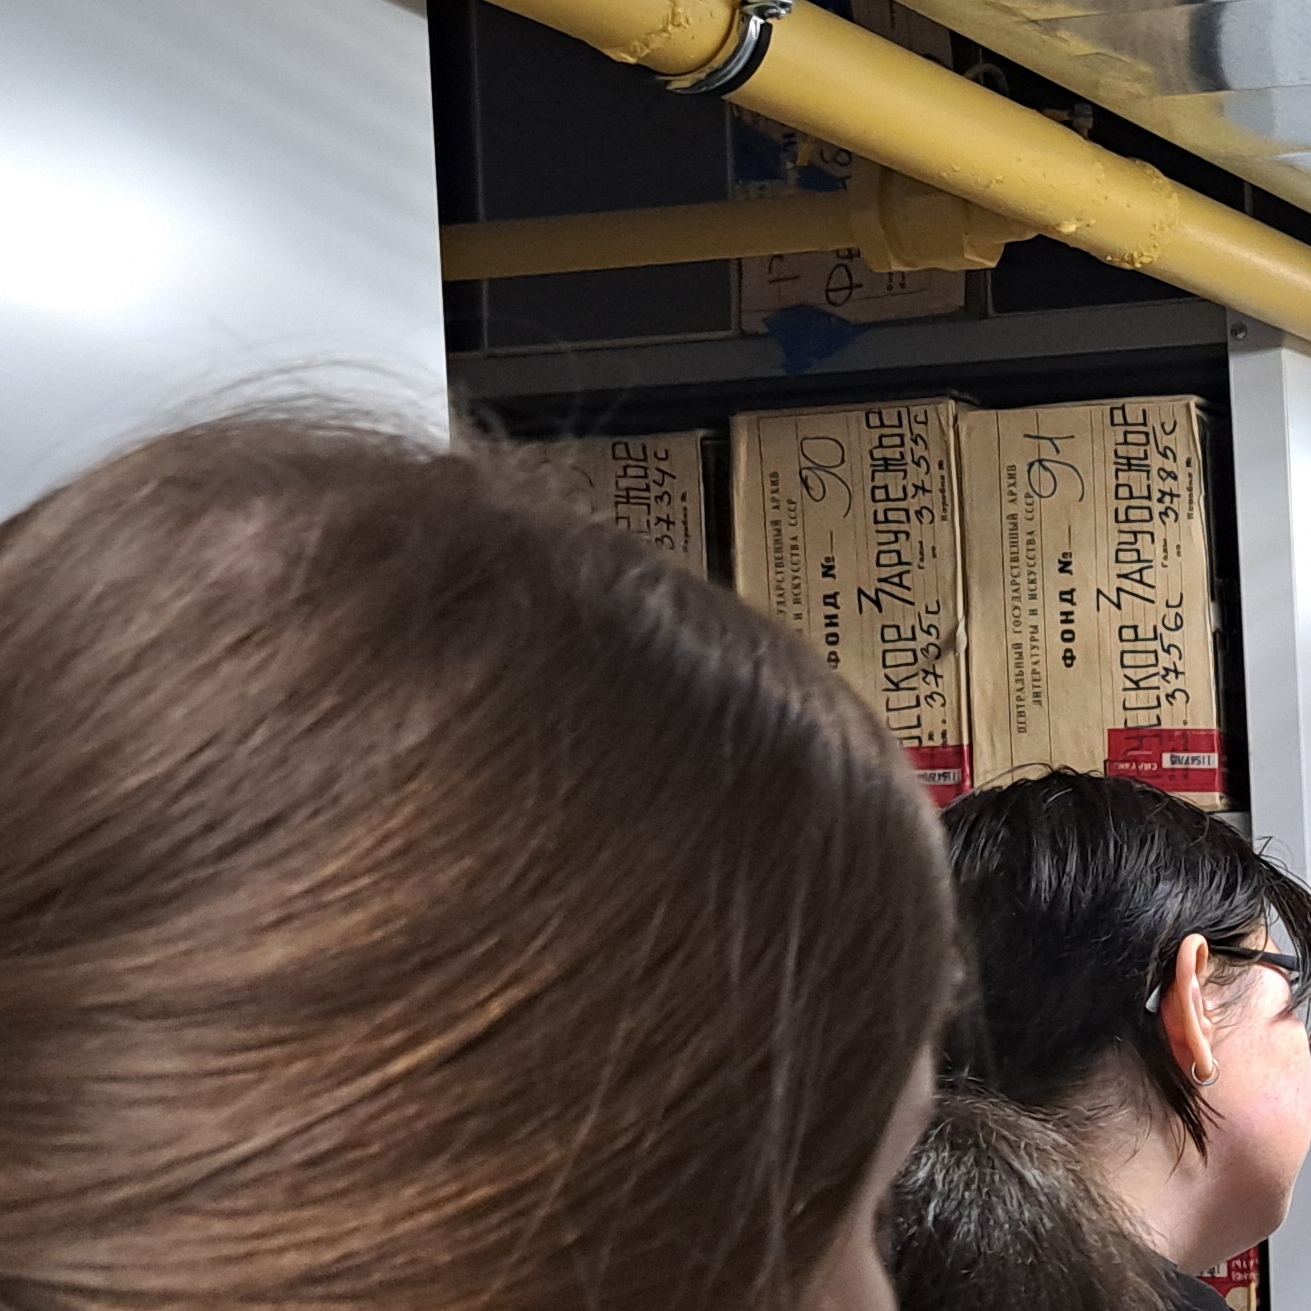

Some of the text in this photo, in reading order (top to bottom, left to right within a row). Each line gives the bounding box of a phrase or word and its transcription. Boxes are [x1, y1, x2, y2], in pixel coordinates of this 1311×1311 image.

[798, 435, 851, 519] 90
[1024, 432, 1085, 503] 91
[769, 470, 786, 617] УДАРСТВЕННЫЙ АРХИВ
[787, 498, 798, 527] СССР
[787, 534, 802, 605] ИСКУССТВА
[1005, 464, 1028, 734] ЦЕНТРАЛЬНЫЙ ГОСУДАРСТВЕННЫЙ АРХИВ
[1023, 491, 1043, 708] ЛИТЕРАТУРЫ И ИСКУССТВА СССР
[823, 591, 840, 670] ФОНД
[1058, 588, 1077, 669] ФОНД
[879, 624, 922, 748] УССКОЕ
